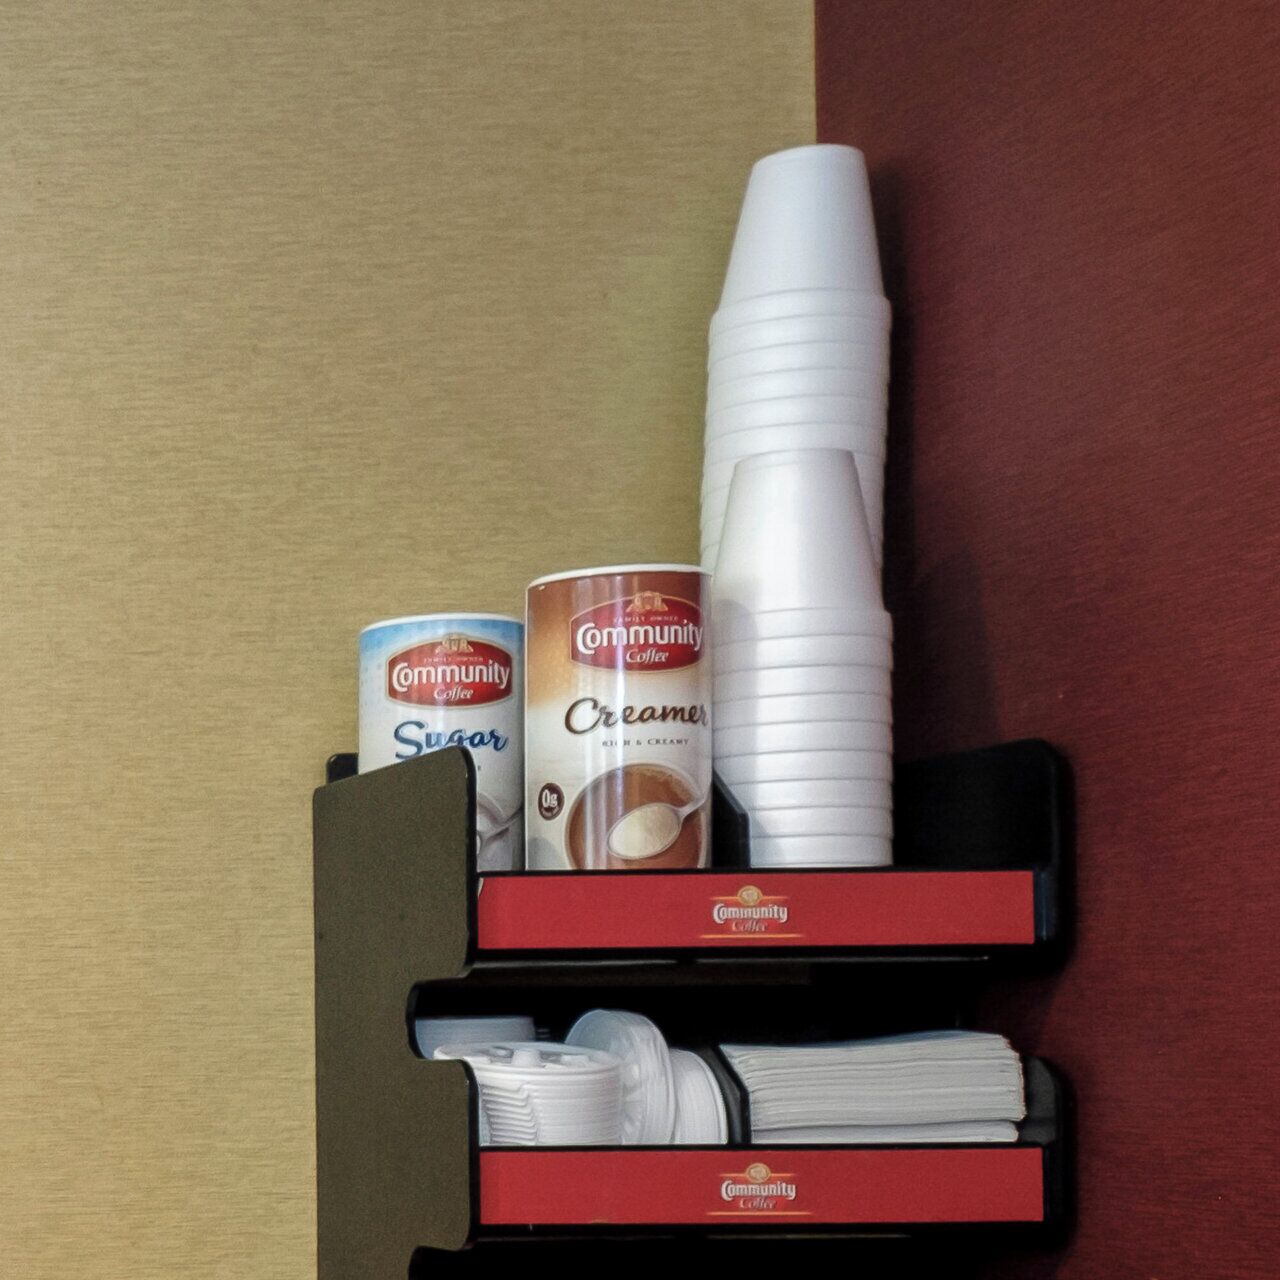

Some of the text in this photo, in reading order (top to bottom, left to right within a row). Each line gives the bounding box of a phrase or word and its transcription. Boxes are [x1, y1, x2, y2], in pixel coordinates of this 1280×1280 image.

[576, 619, 703, 654] Community
[626, 649, 668, 664] Coffee
[392, 659, 510, 692] Community
[434, 686, 473, 700] Coffee
[647, 738, 689, 746] CREAMY
[713, 901, 788, 925] Community
[720, 1178, 796, 1202] Community
